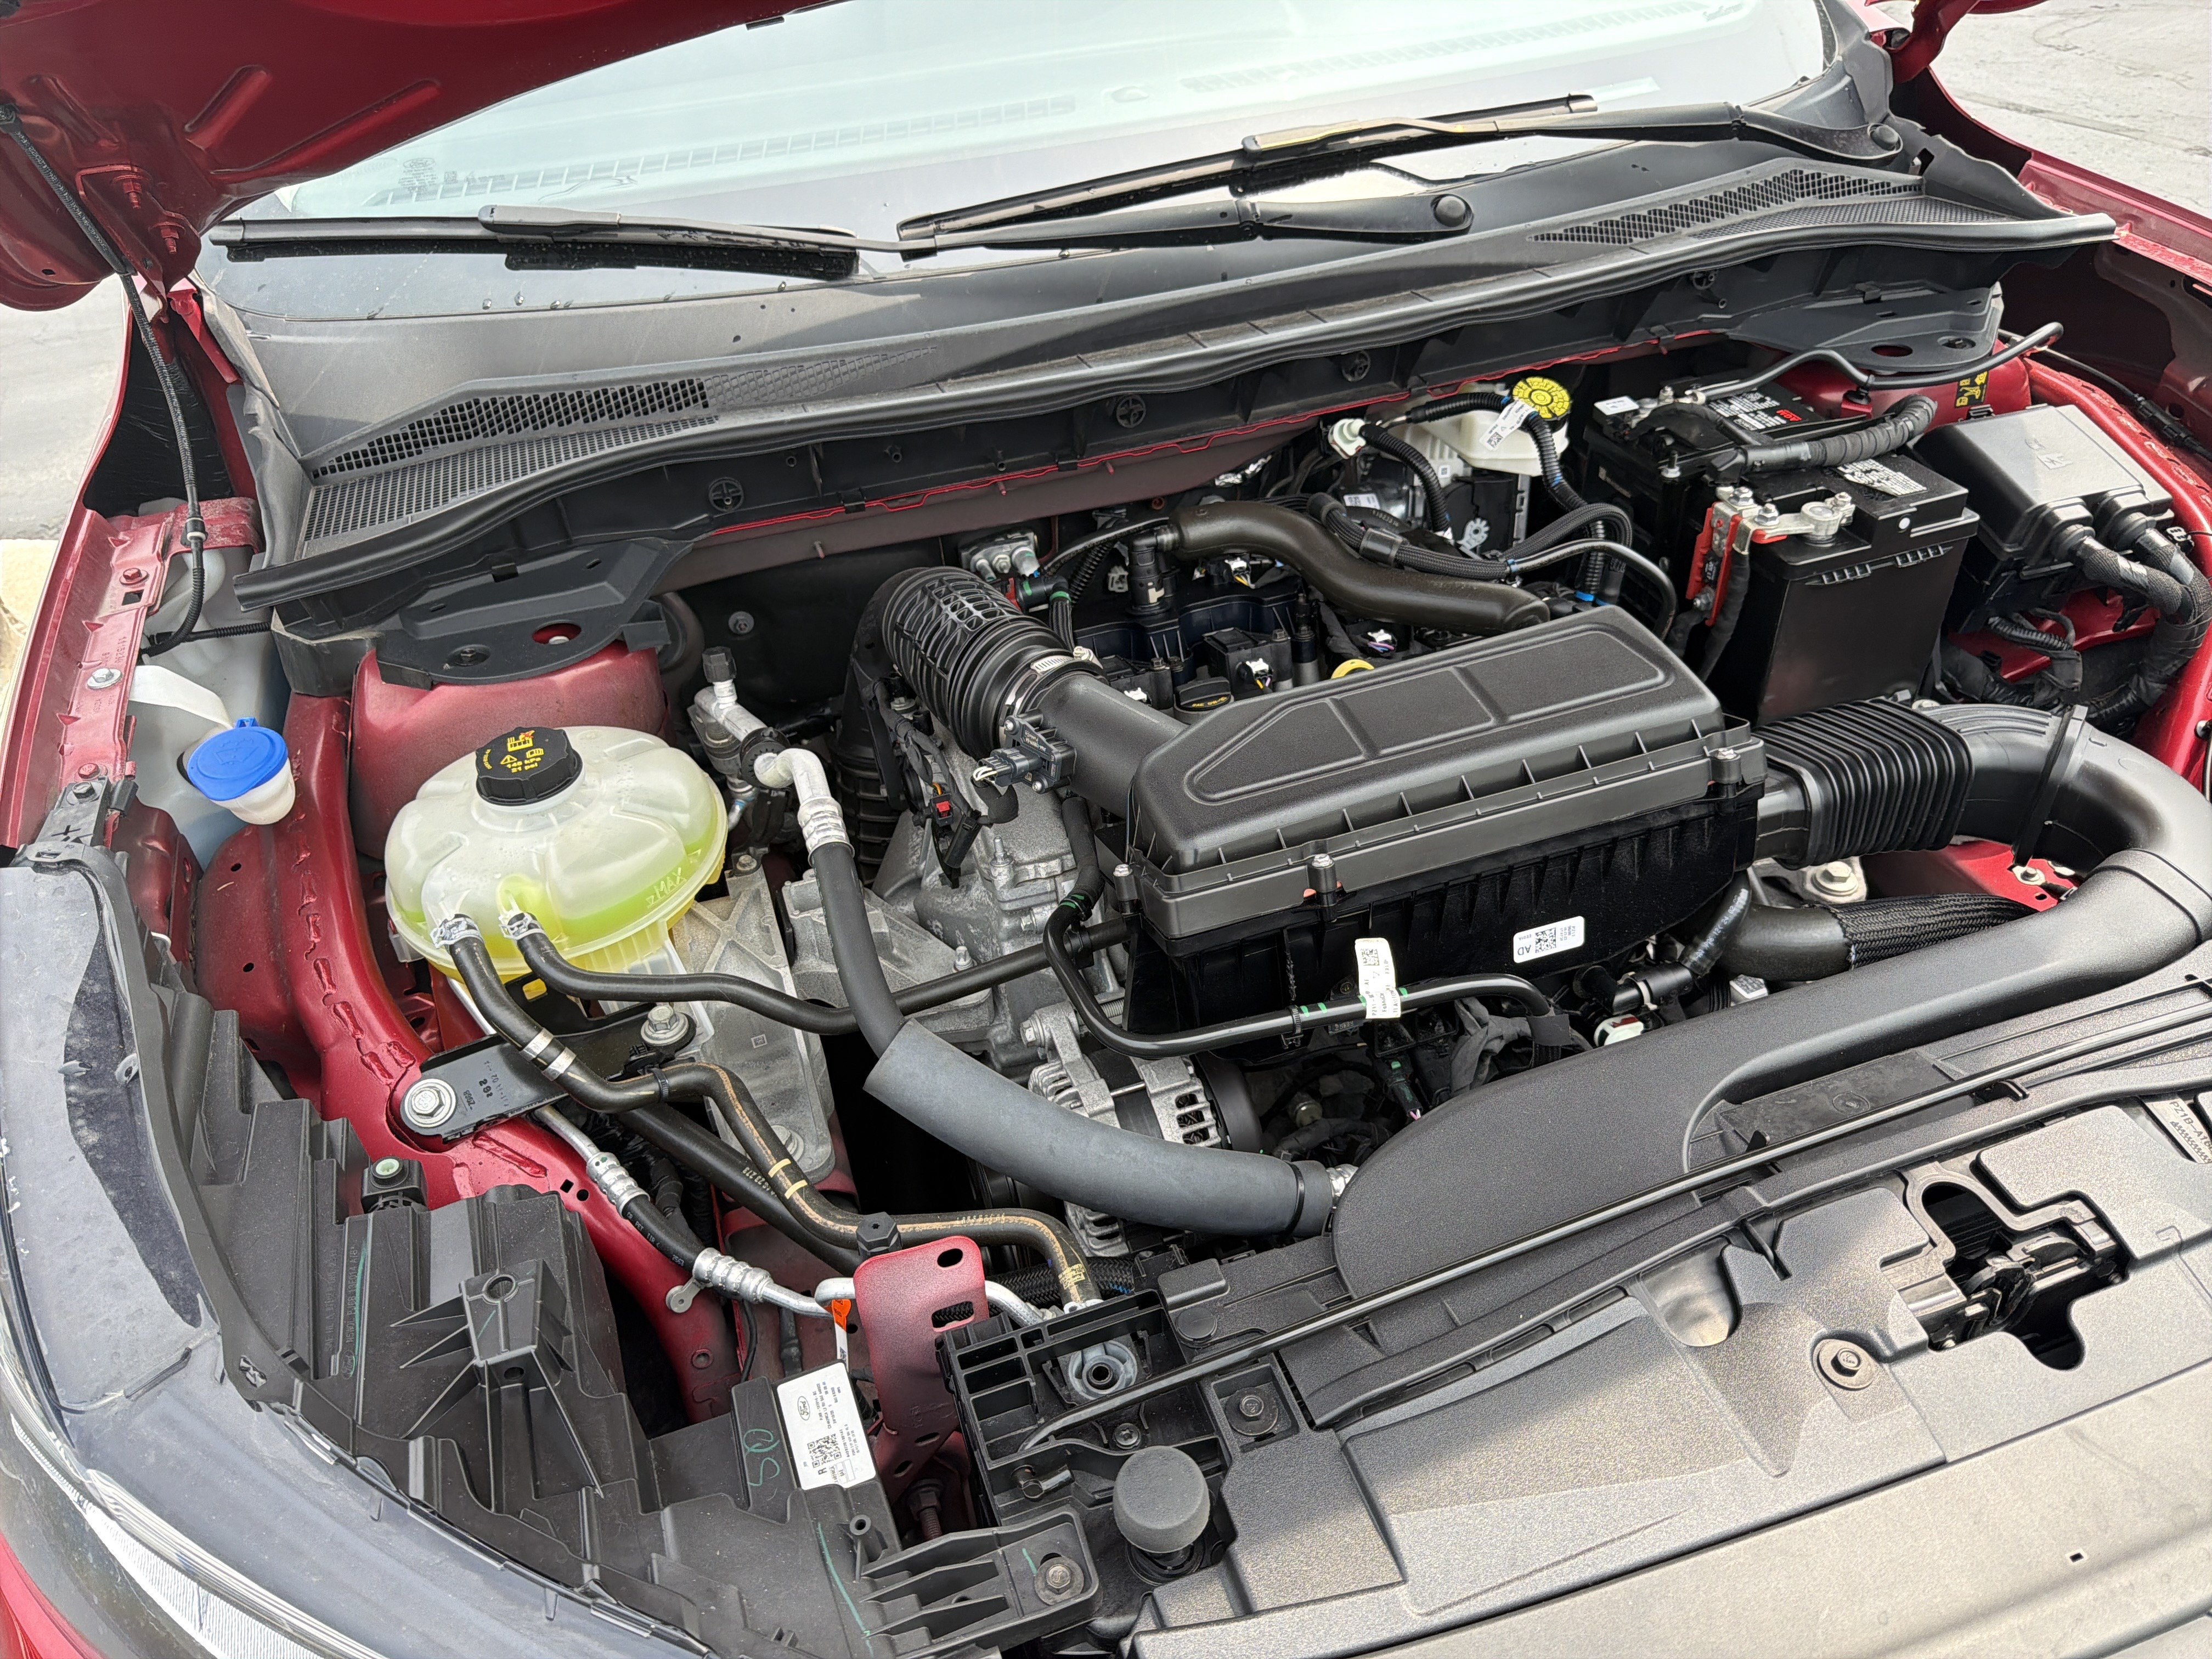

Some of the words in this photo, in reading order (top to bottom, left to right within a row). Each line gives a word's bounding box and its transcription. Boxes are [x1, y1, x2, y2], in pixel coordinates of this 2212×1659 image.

[656, 867, 687, 897] MAX
[1516, 944, 1533, 957] AD
[798, 1400, 810, 1417] Ford
